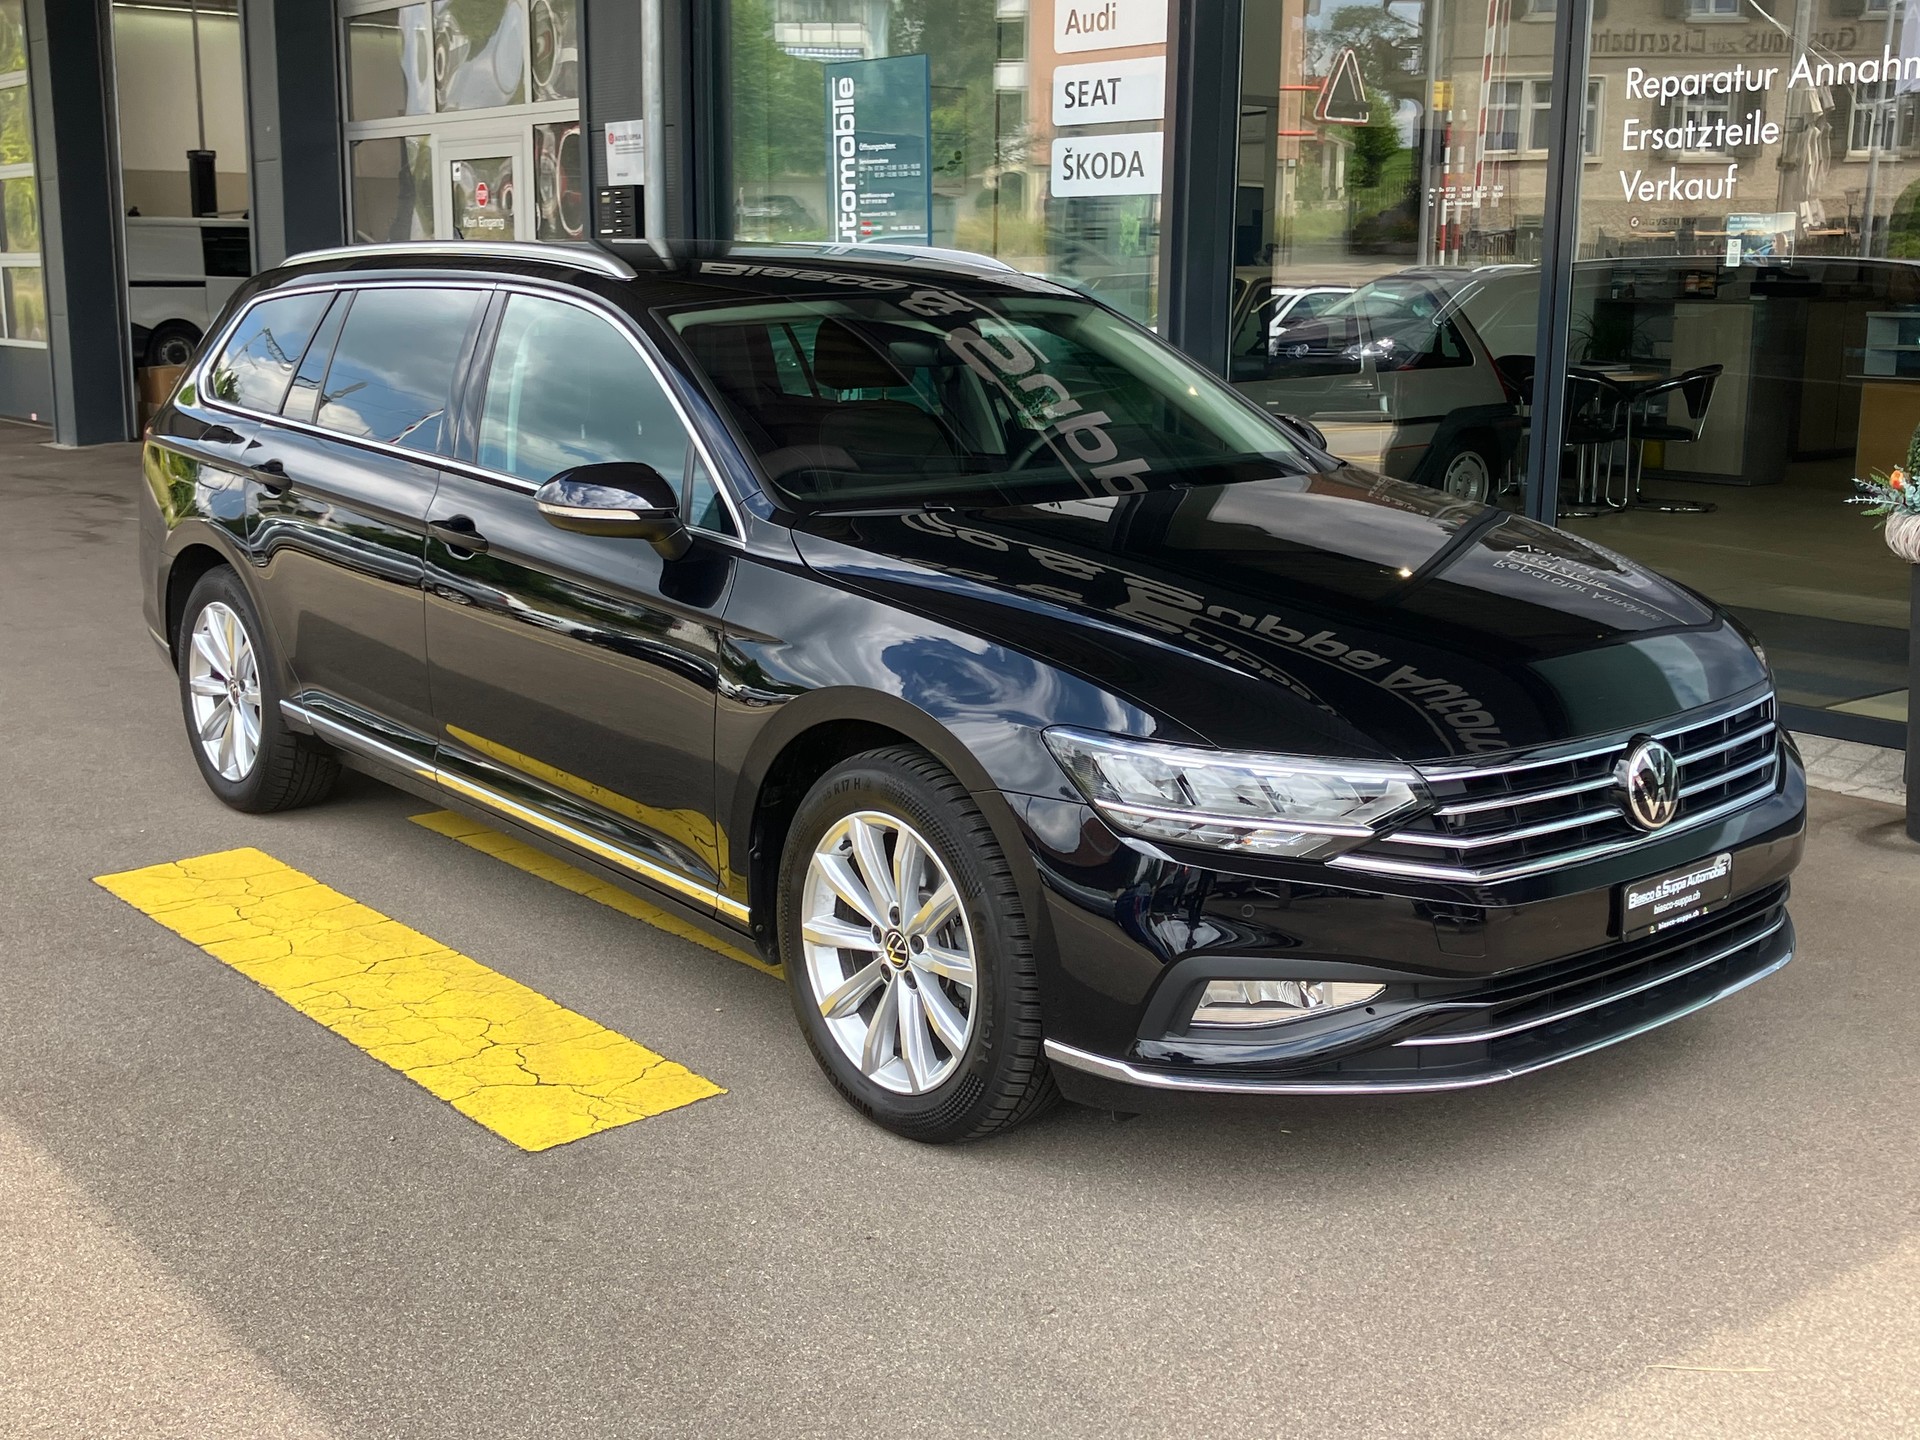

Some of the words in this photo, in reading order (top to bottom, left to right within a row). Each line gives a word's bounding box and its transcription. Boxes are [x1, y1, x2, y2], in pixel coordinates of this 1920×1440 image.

[1064, 2, 1116, 35] Audi
[1064, 77, 1122, 109] SEAT
[1625, 63, 1779, 106] Reparatur
[1622, 109, 1780, 151] Ersatzteile
[1062, 147, 1145, 181] ŠKODA
[1619, 163, 1738, 202] Verkauf
[1628, 890, 1656, 910] Biasco
[1662, 879, 1687, 896] Suppa
[1686, 864, 1727, 888] Automobile
[1653, 889, 1702, 915] biasco-suppa.ch
